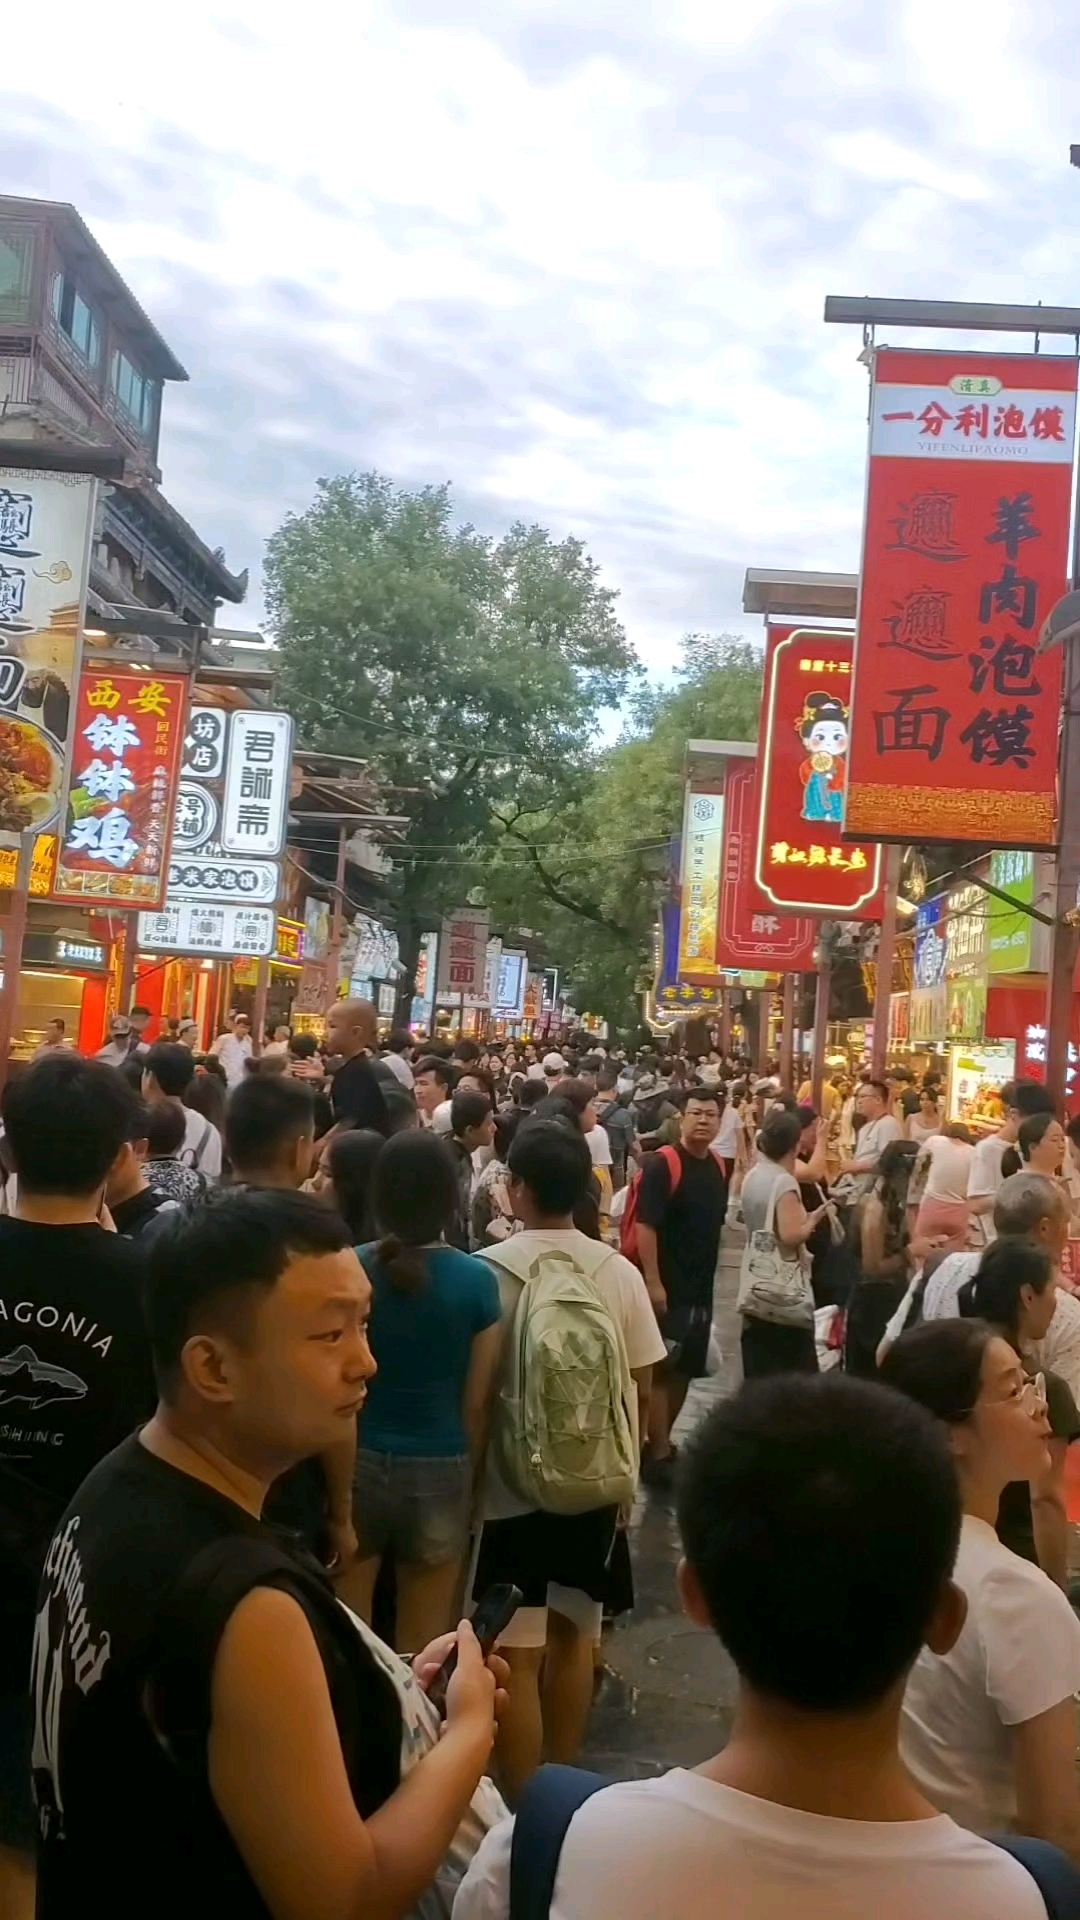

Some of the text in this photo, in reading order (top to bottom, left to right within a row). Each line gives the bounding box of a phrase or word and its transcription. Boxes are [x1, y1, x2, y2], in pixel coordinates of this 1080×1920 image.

[959, 378, 991, 393] 清真
[881, 401, 1066, 441] 一分利泡馍
[917, 441, 1028, 455] YIFENLIPAOMO
[960, 490, 1043, 769] 羊肉泡馍
[86, 679, 171, 716] 西安
[65, 713, 142, 869] 钵钵鸡
[751, 914, 782, 936] 酥
